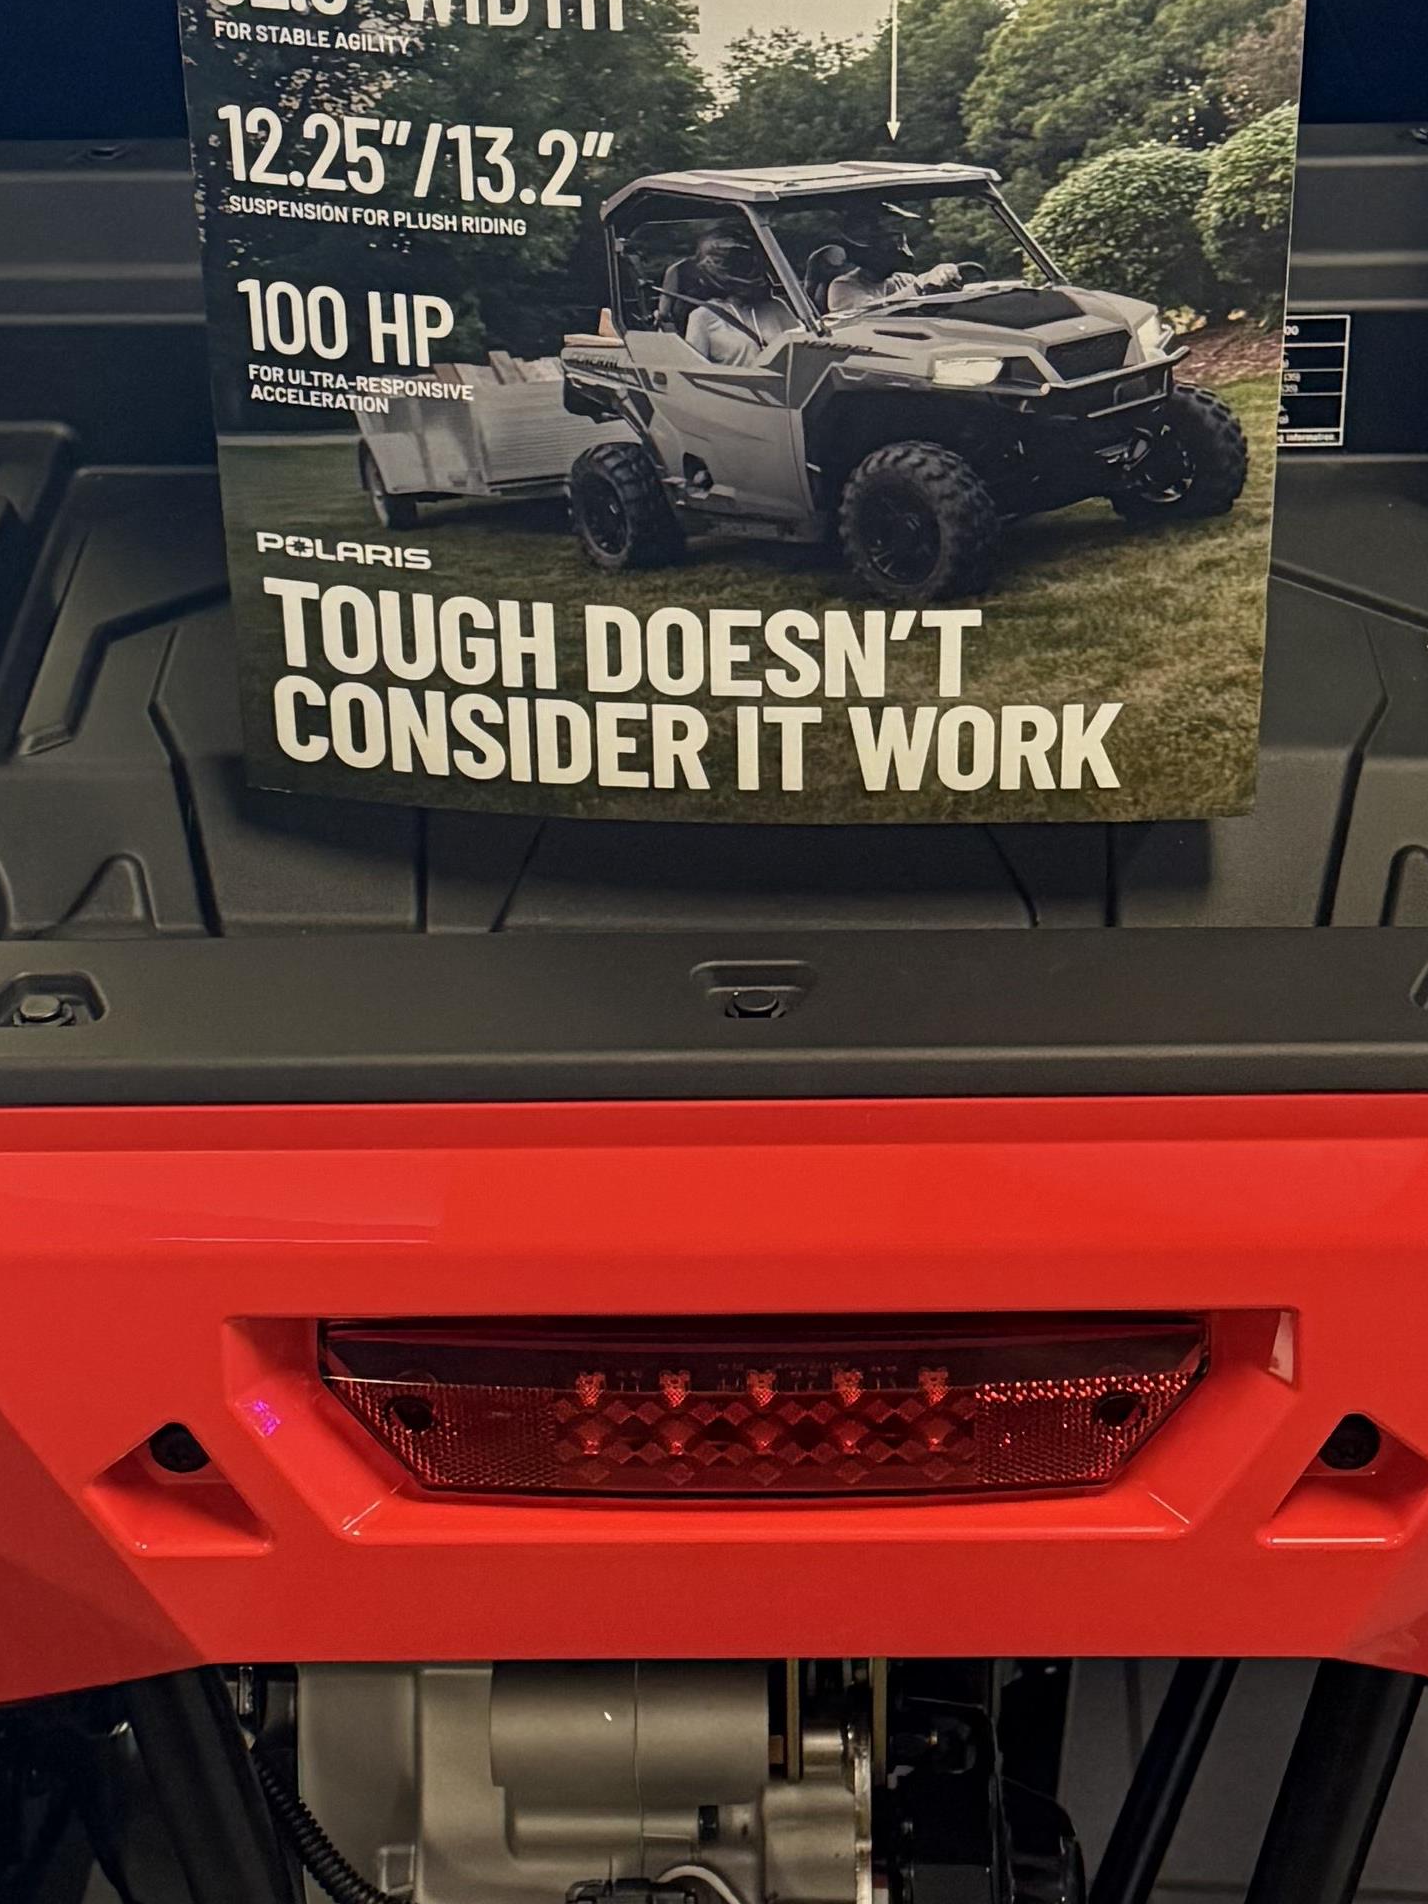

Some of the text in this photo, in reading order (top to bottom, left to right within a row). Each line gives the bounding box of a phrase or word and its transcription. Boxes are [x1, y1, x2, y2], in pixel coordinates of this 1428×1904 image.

[214, 19, 410, 55] FOR STABLE AGILITY
[229, 194, 527, 236] SUSPENSION FOR PLUSH RIDING
[236, 278, 455, 368] 100 HP
[248, 363, 475, 402] FOR ULTRA-RESPONSIVE
[250, 384, 390, 415] ACCELERATION
[256, 531, 432, 571] POLARIS
[263, 576, 983, 699] TOUGH DOESN'T
[273, 675, 1124, 792] CONSIDER IT WORK
